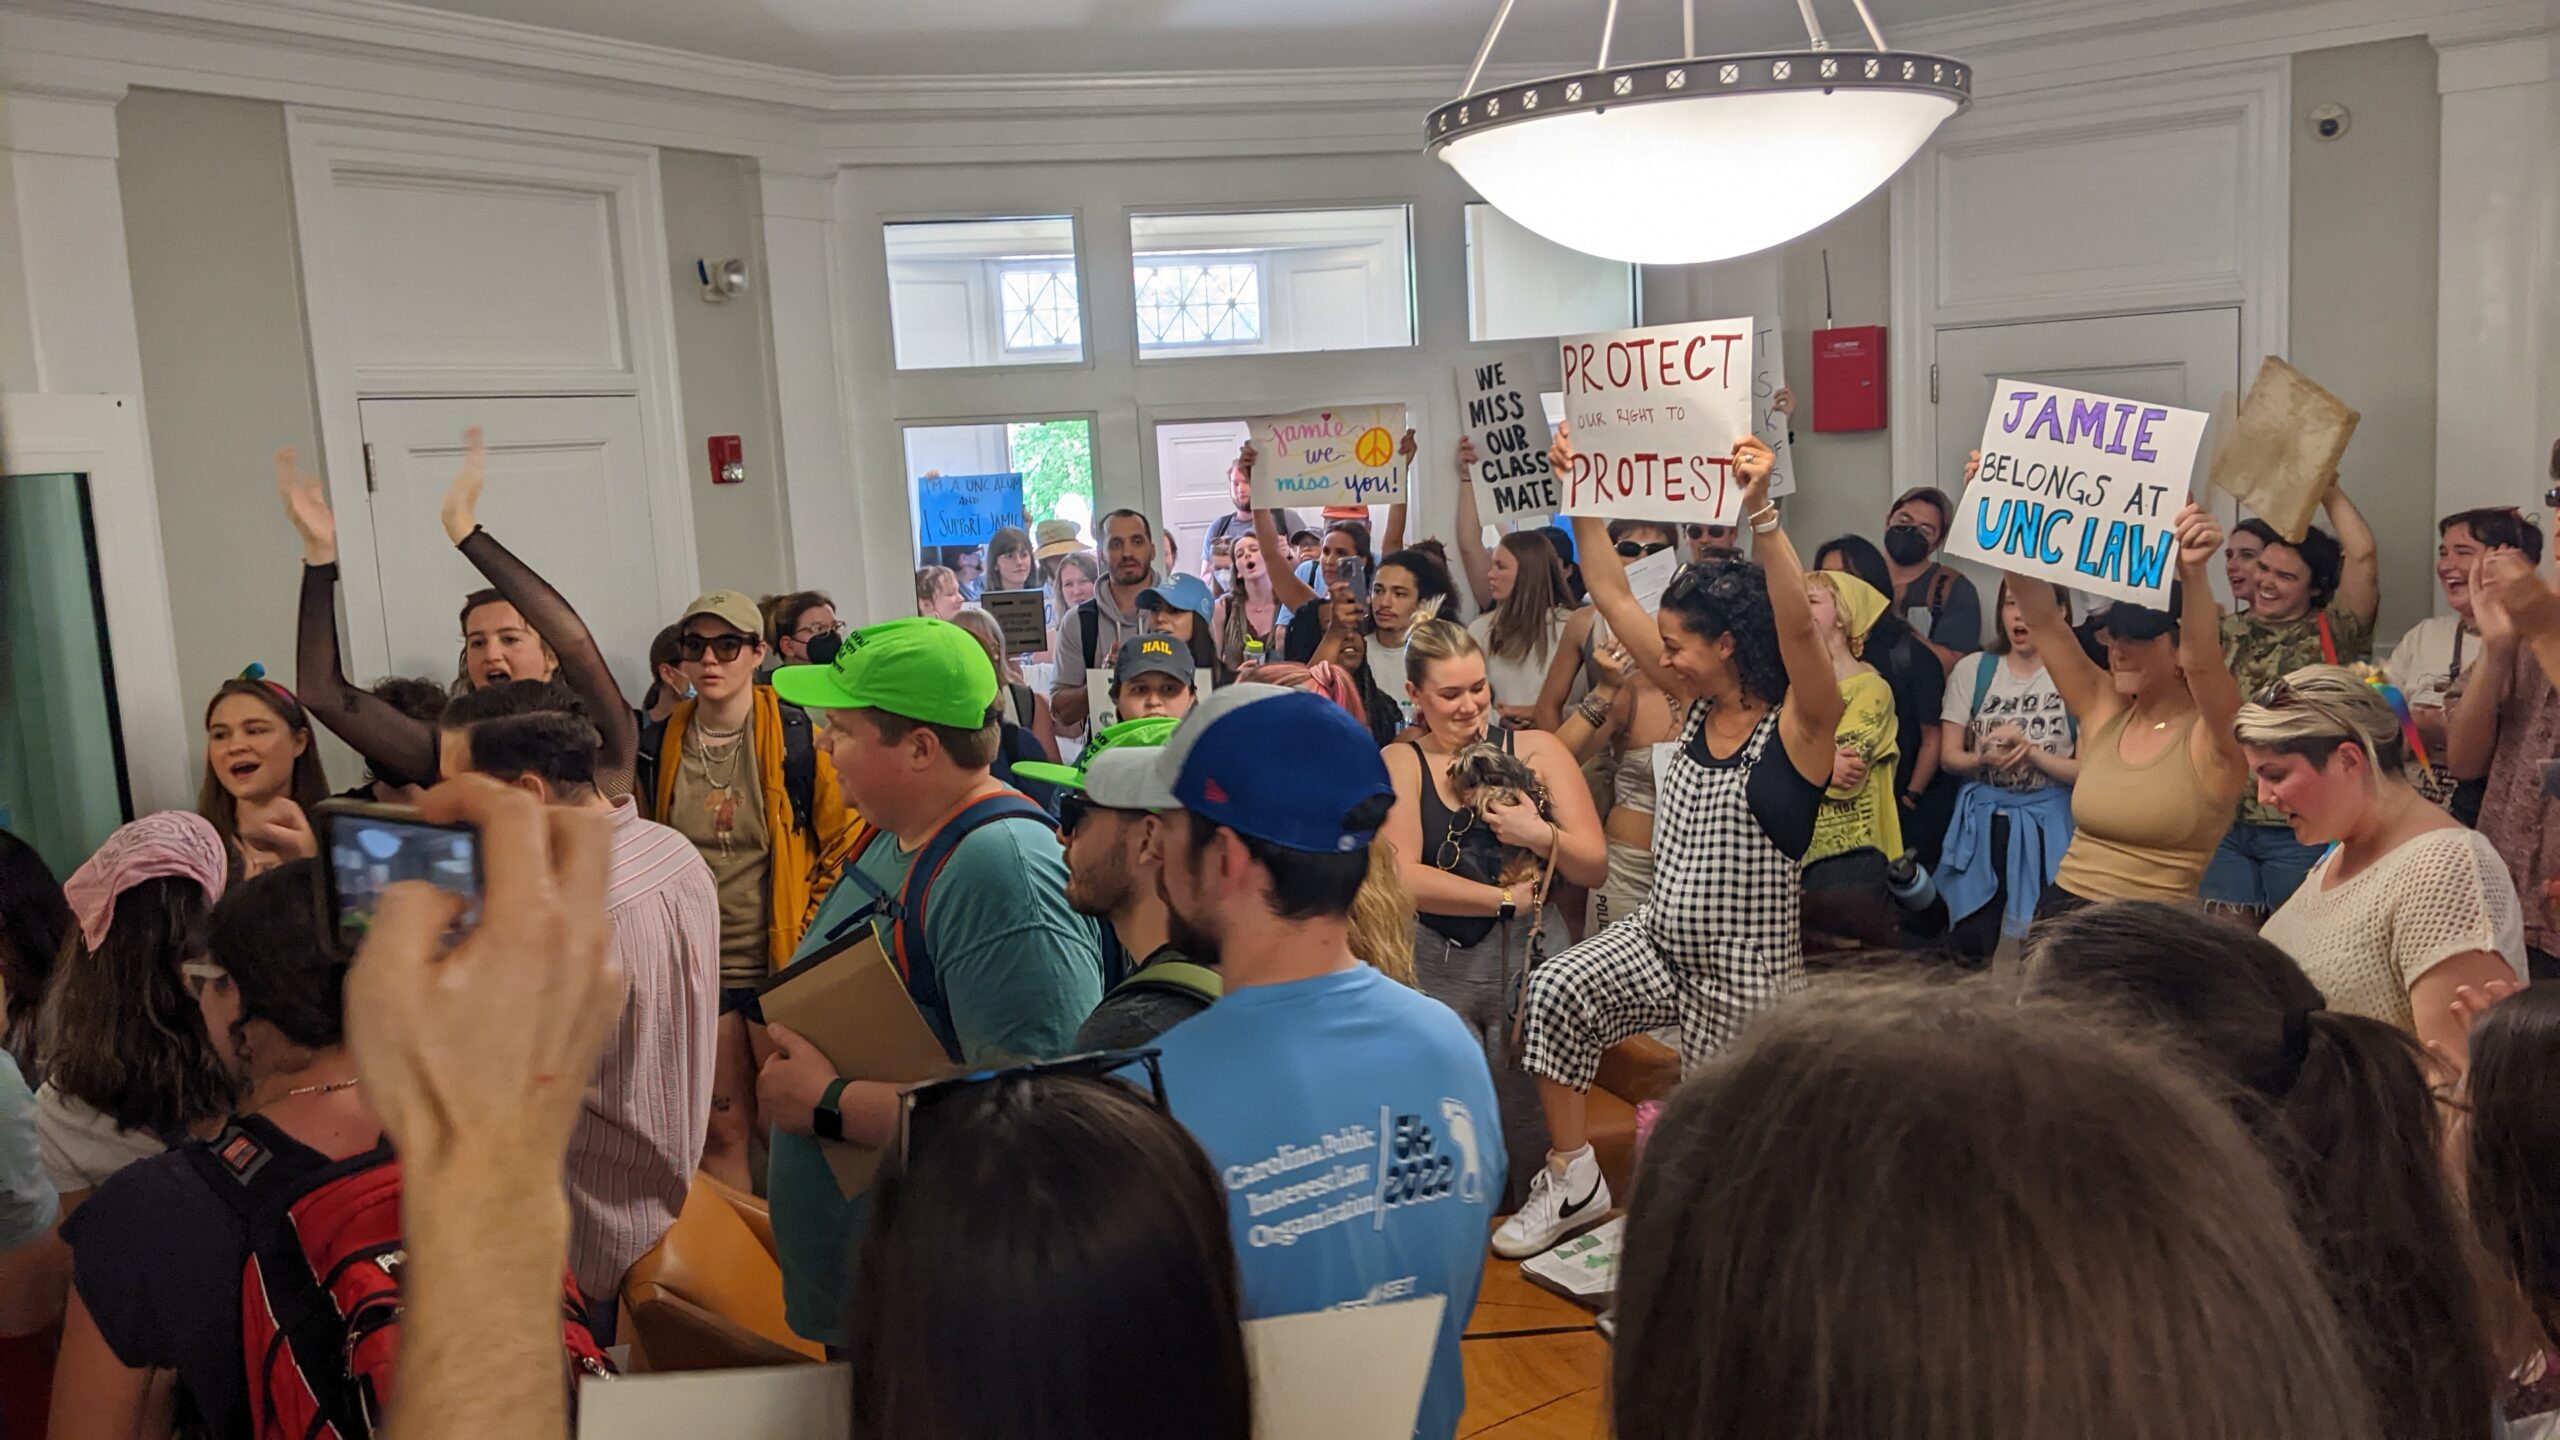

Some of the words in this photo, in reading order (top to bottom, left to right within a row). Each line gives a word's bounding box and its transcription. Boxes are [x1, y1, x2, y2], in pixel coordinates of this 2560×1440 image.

[1475, 362, 1506, 391] WE
[1563, 333, 1743, 395] PROTECT
[1468, 391, 1524, 428] MISS
[1577, 413, 1606, 430] OUR
[1617, 408, 1655, 426] RIGHT
[1666, 406, 1685, 421] TO
[2002, 392, 2169, 463] JAMIE
[1260, 413, 1357, 458] jamie
[1486, 424, 1529, 455] OUR
[1306, 447, 1345, 464] we
[1482, 450, 1550, 483] CLASS
[951, 479, 960, 493] A
[966, 478, 989, 493] UNC
[958, 496, 980, 506] AND
[1275, 474, 1338, 491] miss
[1345, 467, 1398, 503] you!
[1493, 478, 1557, 514] MATE
[1570, 453, 1734, 519] PROTEST
[1980, 452, 2112, 507] BELONGS
[2123, 482, 2169, 516] AT
[1976, 496, 2074, 565] UNC
[2074, 516, 2174, 590] LAW
[1141, 640, 1173, 656] HAIL
[1223, 1143, 1324, 1190] Carolina
[1320, 1123, 1376, 1157] Public
[1332, 1164, 1371, 1193] Law
